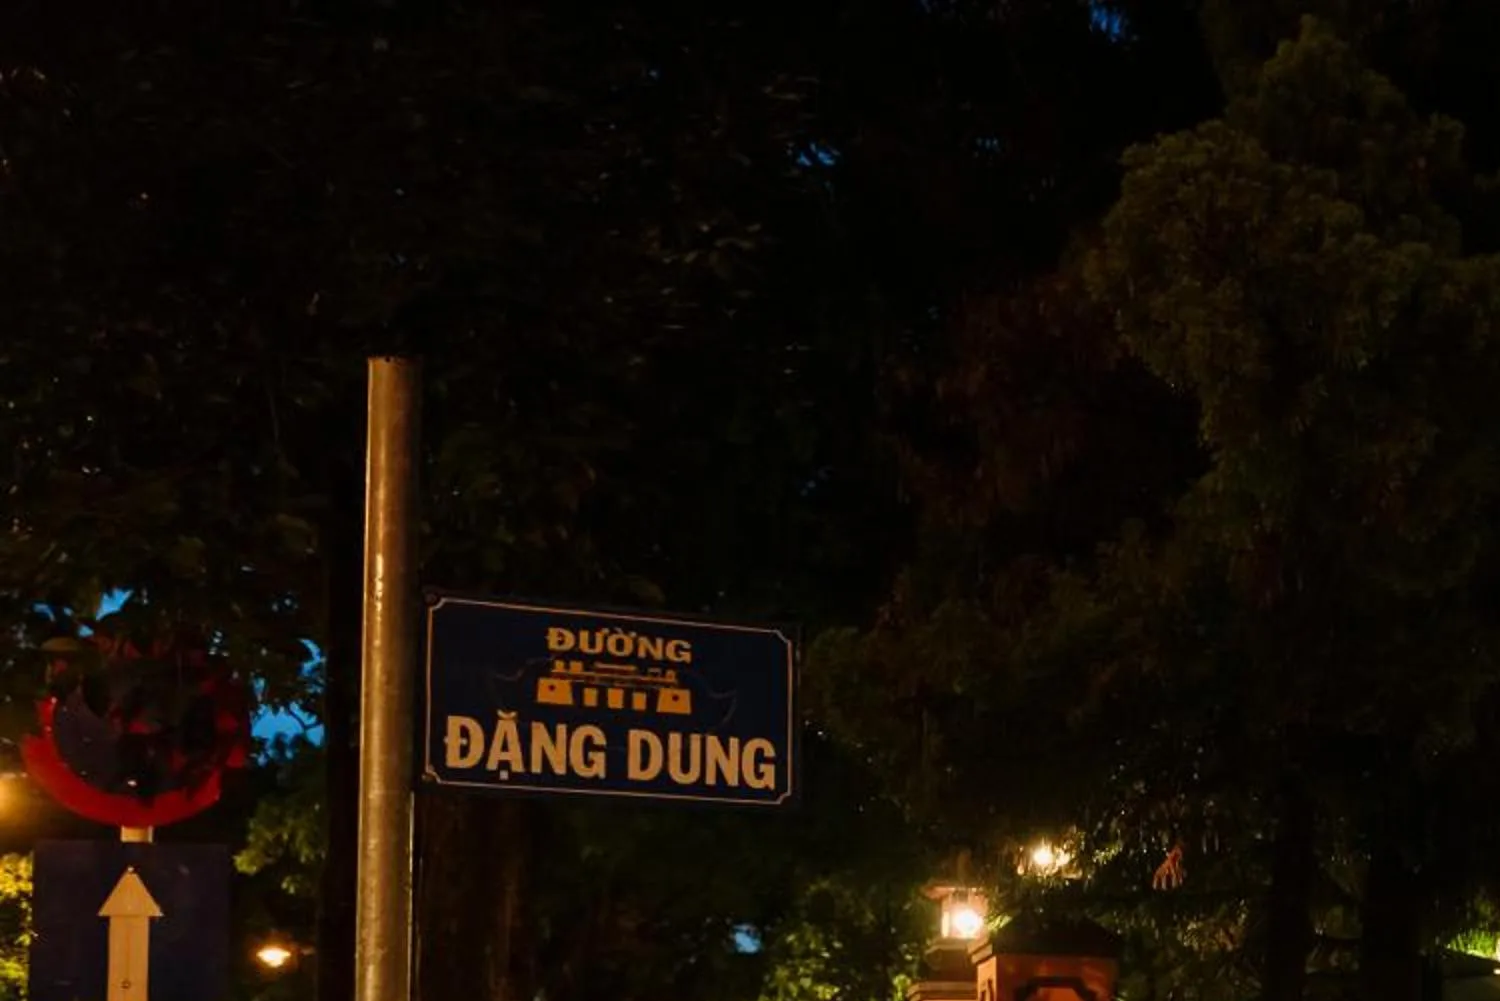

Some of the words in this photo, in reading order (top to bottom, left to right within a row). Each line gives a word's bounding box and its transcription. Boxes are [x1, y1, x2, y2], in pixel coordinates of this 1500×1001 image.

[545, 626, 692, 663] ĐƯỜNG
[443, 709, 607, 780] ĐẶNG
[626, 728, 776, 790] DUNG
